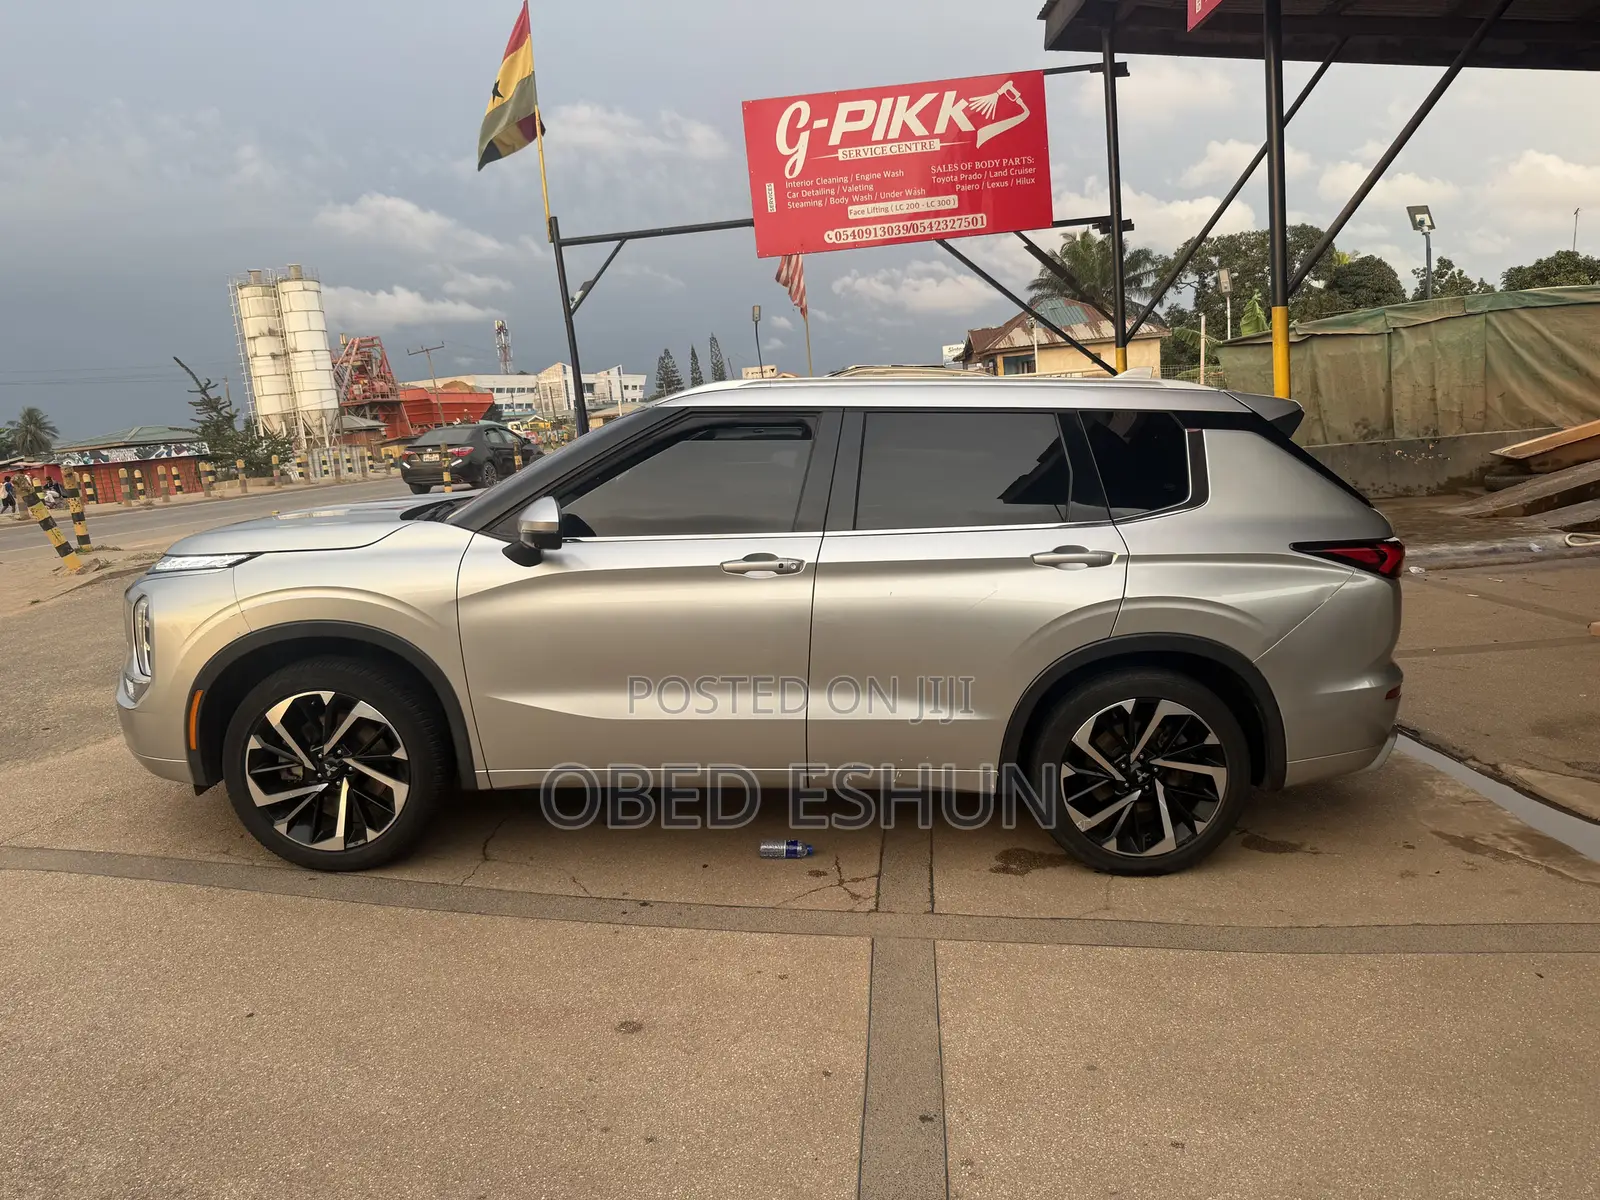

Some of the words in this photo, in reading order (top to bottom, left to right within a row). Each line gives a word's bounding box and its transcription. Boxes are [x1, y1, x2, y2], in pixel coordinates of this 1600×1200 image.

[841, 145, 888, 160] SERVICE
[889, 140, 936, 155] CENTRE
[930, 163, 959, 174] SALES
[960, 162, 973, 171] OF
[975, 159, 1001, 170] BODY
[1002, 156, 1035, 167] PARTS:
[785, 179, 814, 189] Interior
[816, 175, 849, 186] Cleaning
[855, 172, 882, 182] Engine
[883, 169, 904, 178] Wash
[932, 174, 958, 185] Toyota
[960, 171, 982, 181] Prado
[989, 168, 1008, 178] Land
[1009, 166, 1036, 176] Cruiser
[987, 179, 1009, 189] Lexus
[1015, 176, 1036, 186] Hilux
[767, 184, 775, 212] SERVICES
[786, 191, 799, 199] Car
[801, 187, 835, 198] Detailing
[842, 183, 874, 193] Valeting
[787, 199, 823, 210] Steaming
[829, 196, 849, 206] Body
[852, 193, 873, 202] Wash
[880, 190, 903, 200] Under
[905, 187, 926, 197] Wash
[849, 208, 865, 216] Face
[866, 206, 889, 215] Lifting
[895, 203, 904, 211] LC
[905, 202, 920, 210] 200
[937, 199, 950, 207] 300
[834, 215, 986, 242] 0540913039/0542327501
